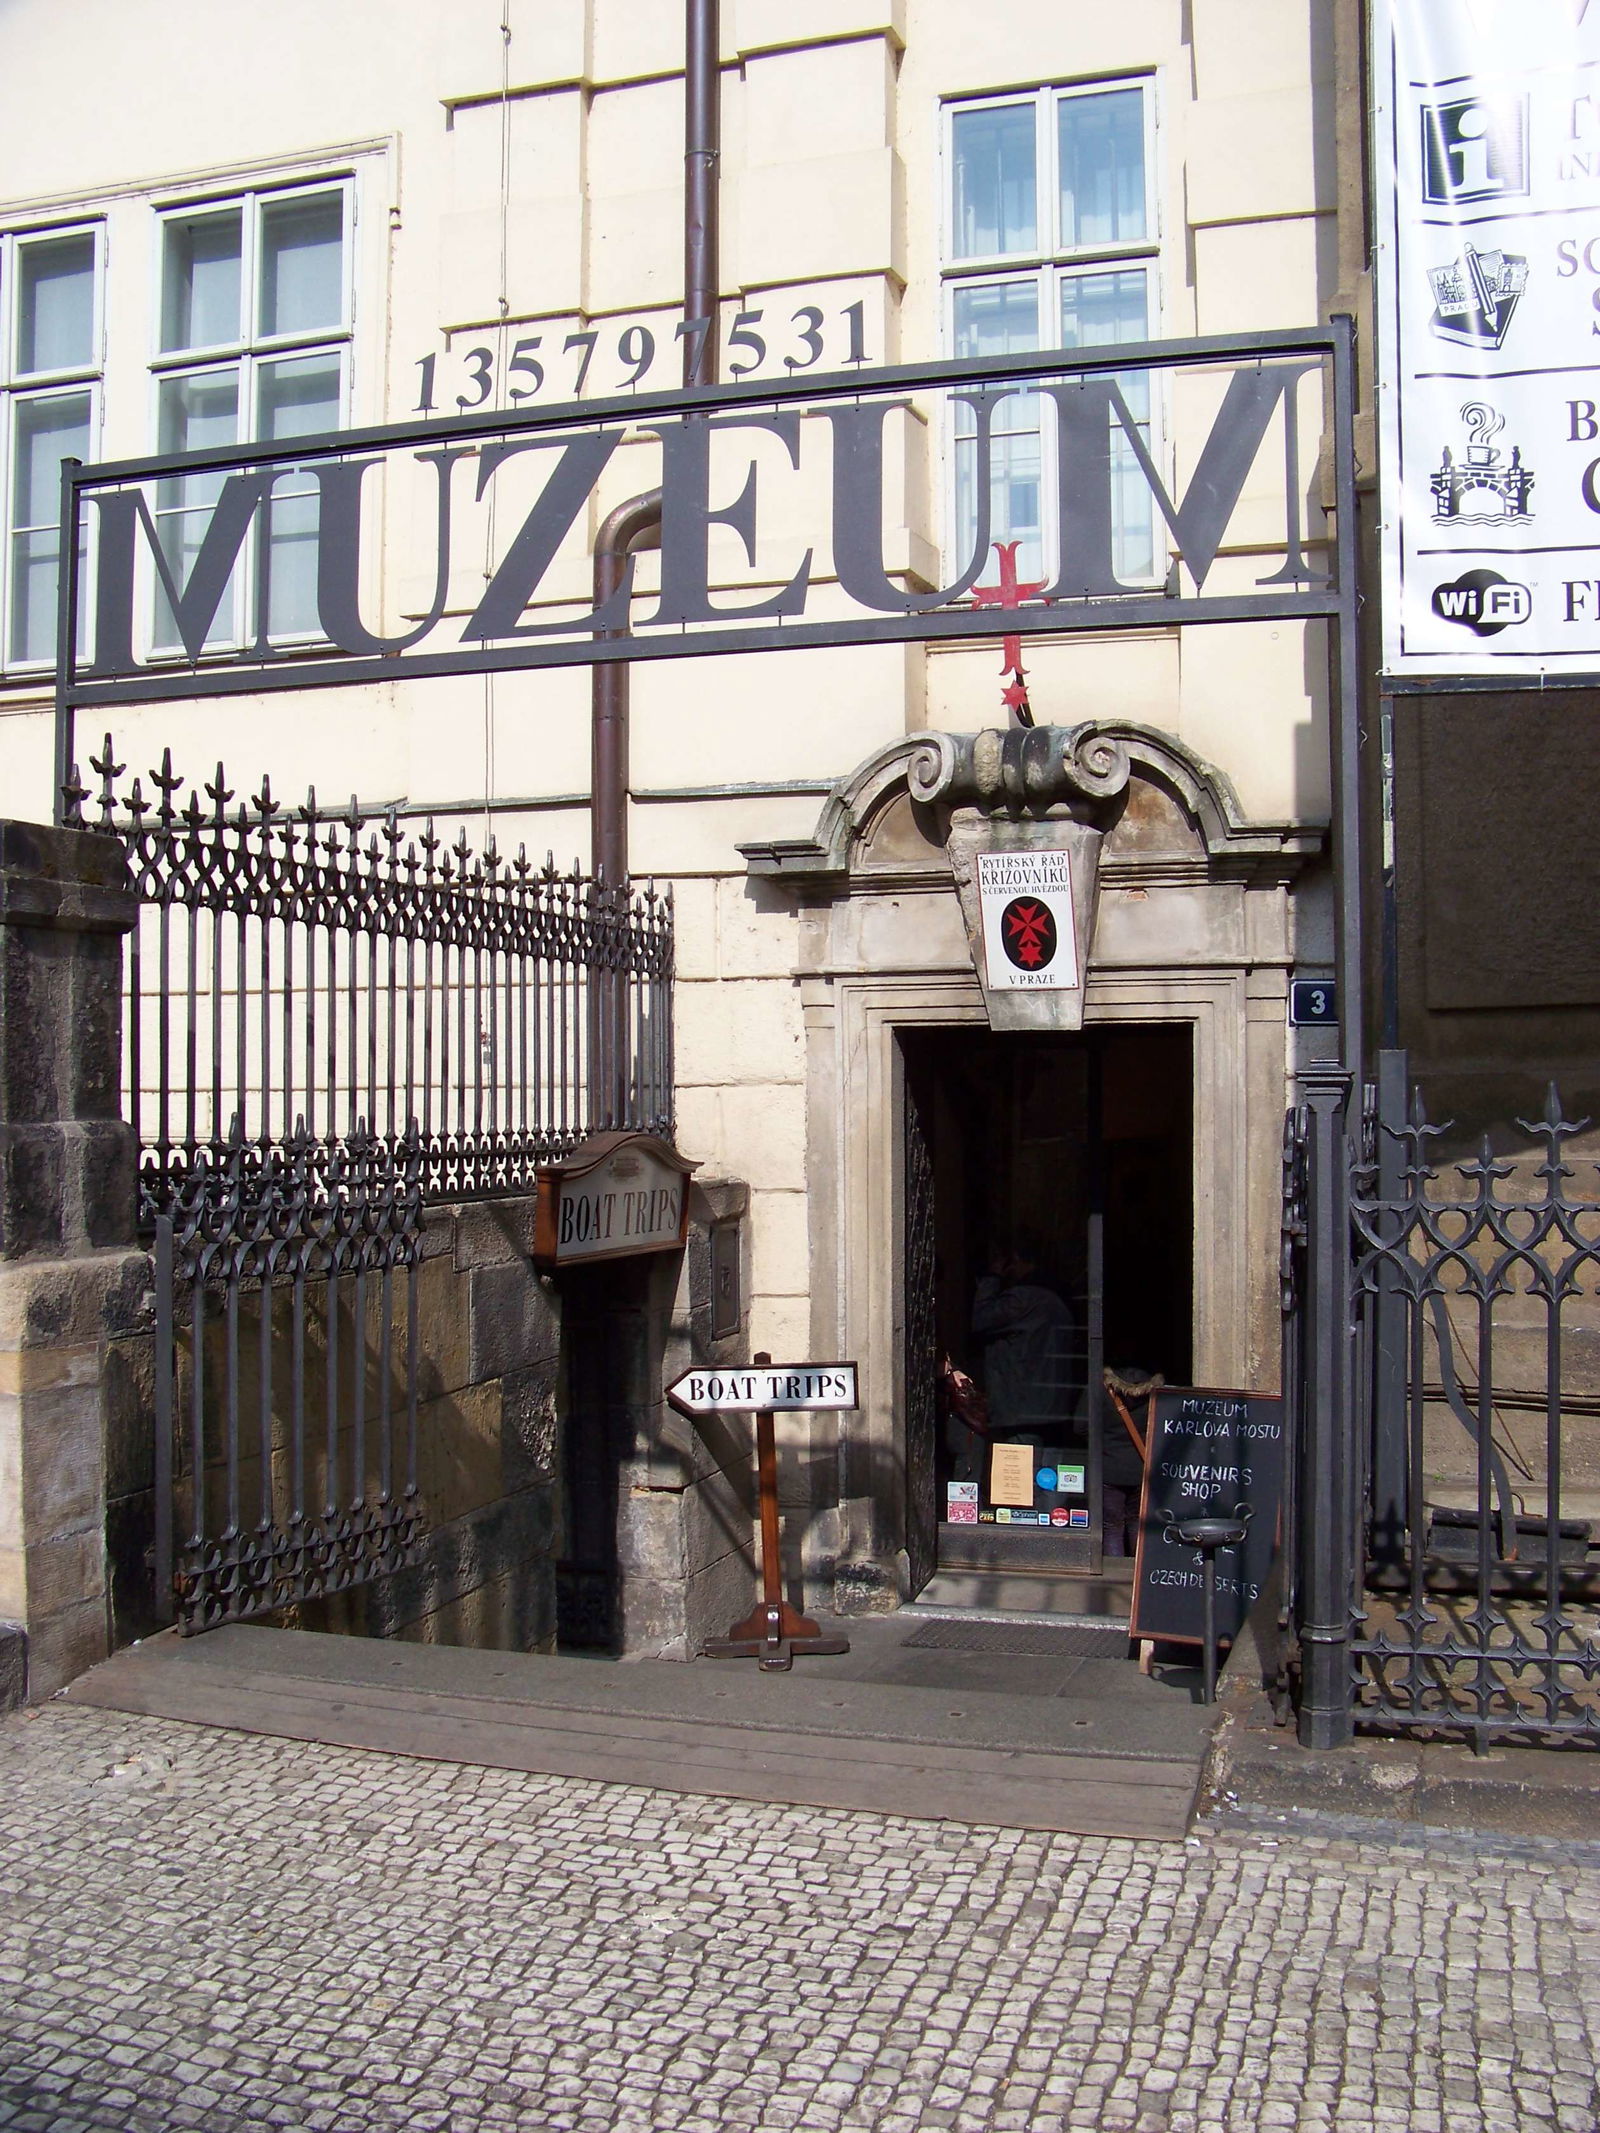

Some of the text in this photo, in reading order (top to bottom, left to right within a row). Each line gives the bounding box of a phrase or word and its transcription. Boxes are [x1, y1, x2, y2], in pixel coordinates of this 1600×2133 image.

[411, 300, 873, 412] 135797531
[1566, 400, 1600, 441] B
[80, 361, 1334, 674] MUZEUM
[1562, 580, 1600, 622] F
[1041, 854, 1065, 867] ŘÁD
[1009, 974, 1056, 985] V PRAZE
[1311, 990, 1326, 1014] 3
[560, 1187, 680, 1244] BOAT TRIPS
[690, 1374, 847, 1401] BOAT TRIPS
[1182, 1399, 1249, 1418] MUZEUM
[1164, 1420, 1280, 1440] KARLOVA MOSTU
[1161, 1463, 1253, 1486] SOUVENIRS
[1181, 1483, 1222, 1500] SHOP
[1150, 1569, 1259, 1600] CZECH DESERTS
